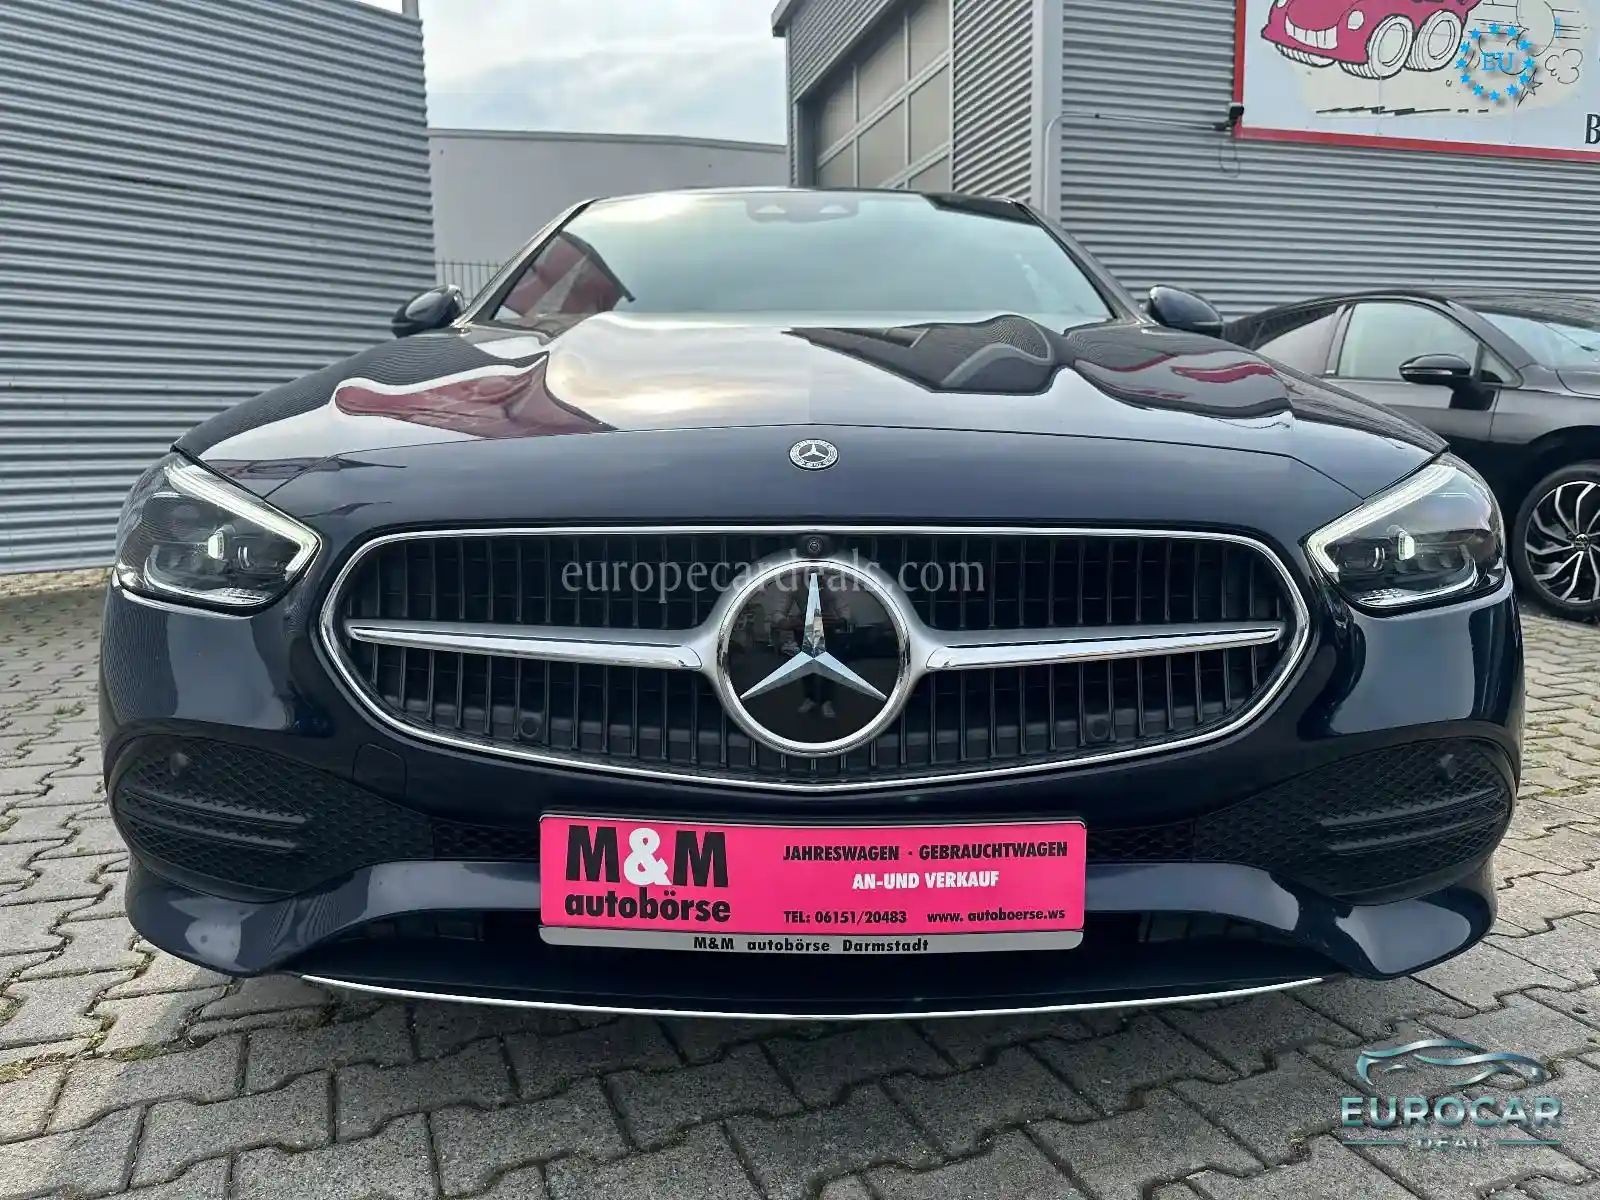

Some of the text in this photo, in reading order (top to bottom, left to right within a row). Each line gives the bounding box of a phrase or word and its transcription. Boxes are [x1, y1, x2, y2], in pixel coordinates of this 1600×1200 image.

[565, 824, 729, 888] M&M
[783, 841, 1068, 861] JAHRESWAGEN GEBRAUCHTWAGEN
[852, 870, 1000, 890] AN-UND VERKAUF
[564, 887, 731, 922] autobörse
[783, 910, 811, 924] TEL:
[814, 910, 907, 924] 06151/20483
[967, 907, 1066, 922] autoboerse.ws
[693, 936, 929, 953] M&M autobörse Darmstadt
